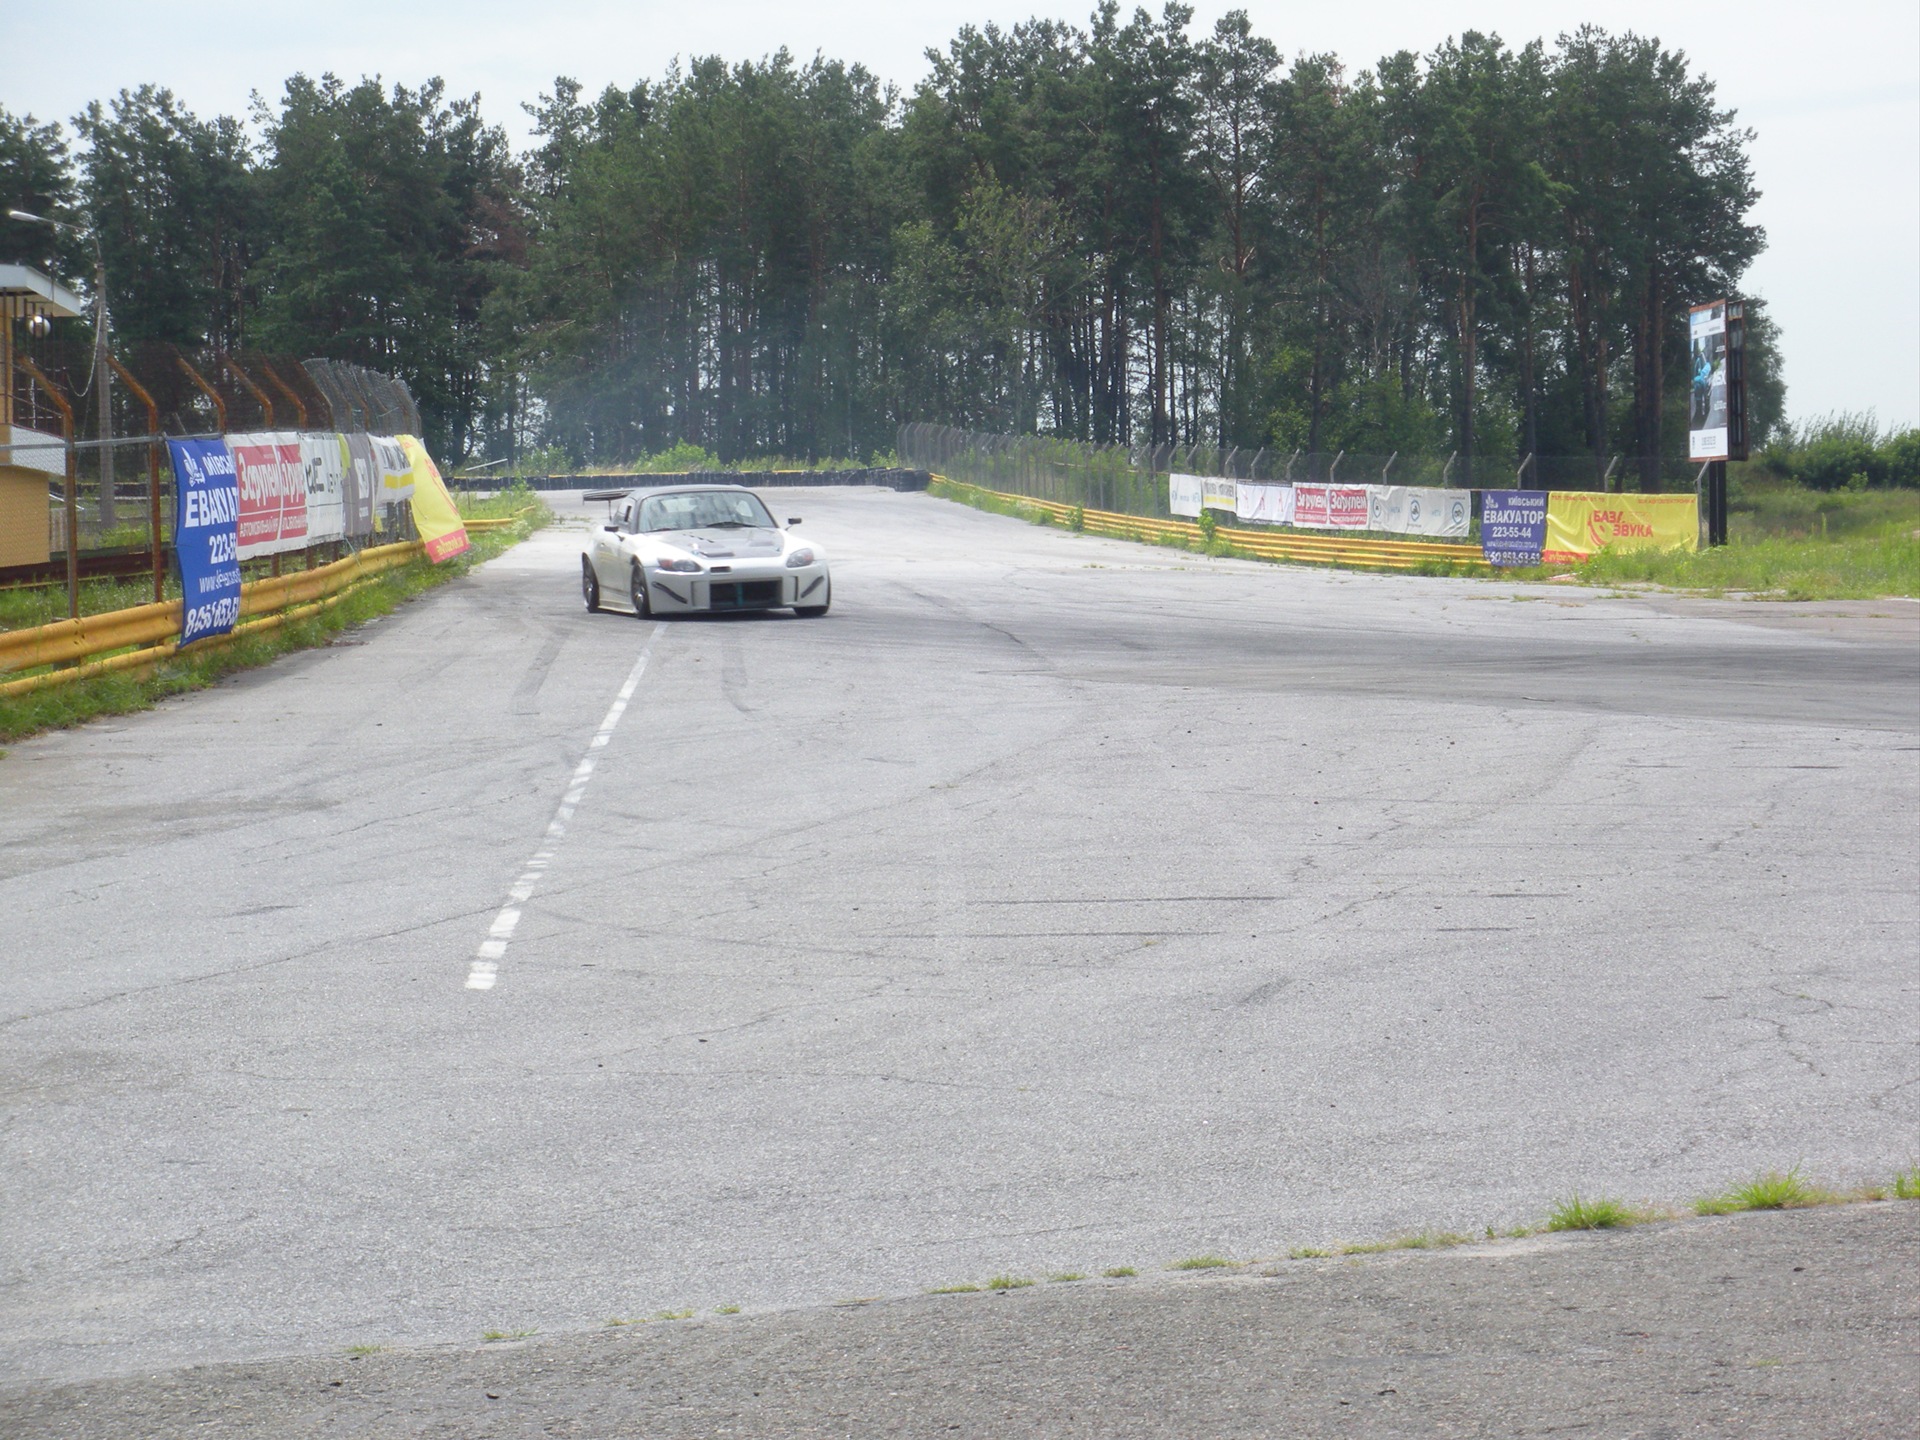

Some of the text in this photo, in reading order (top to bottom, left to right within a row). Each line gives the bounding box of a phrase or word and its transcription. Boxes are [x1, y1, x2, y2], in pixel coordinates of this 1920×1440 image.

[184, 487, 238, 528] ЕВАКУАТ
[1483, 510, 1544, 524] ЕВАКУАТОР
[1492, 526, 1532, 538] 223-55-44
[1612, 524, 1654, 538] ЗВУКА
